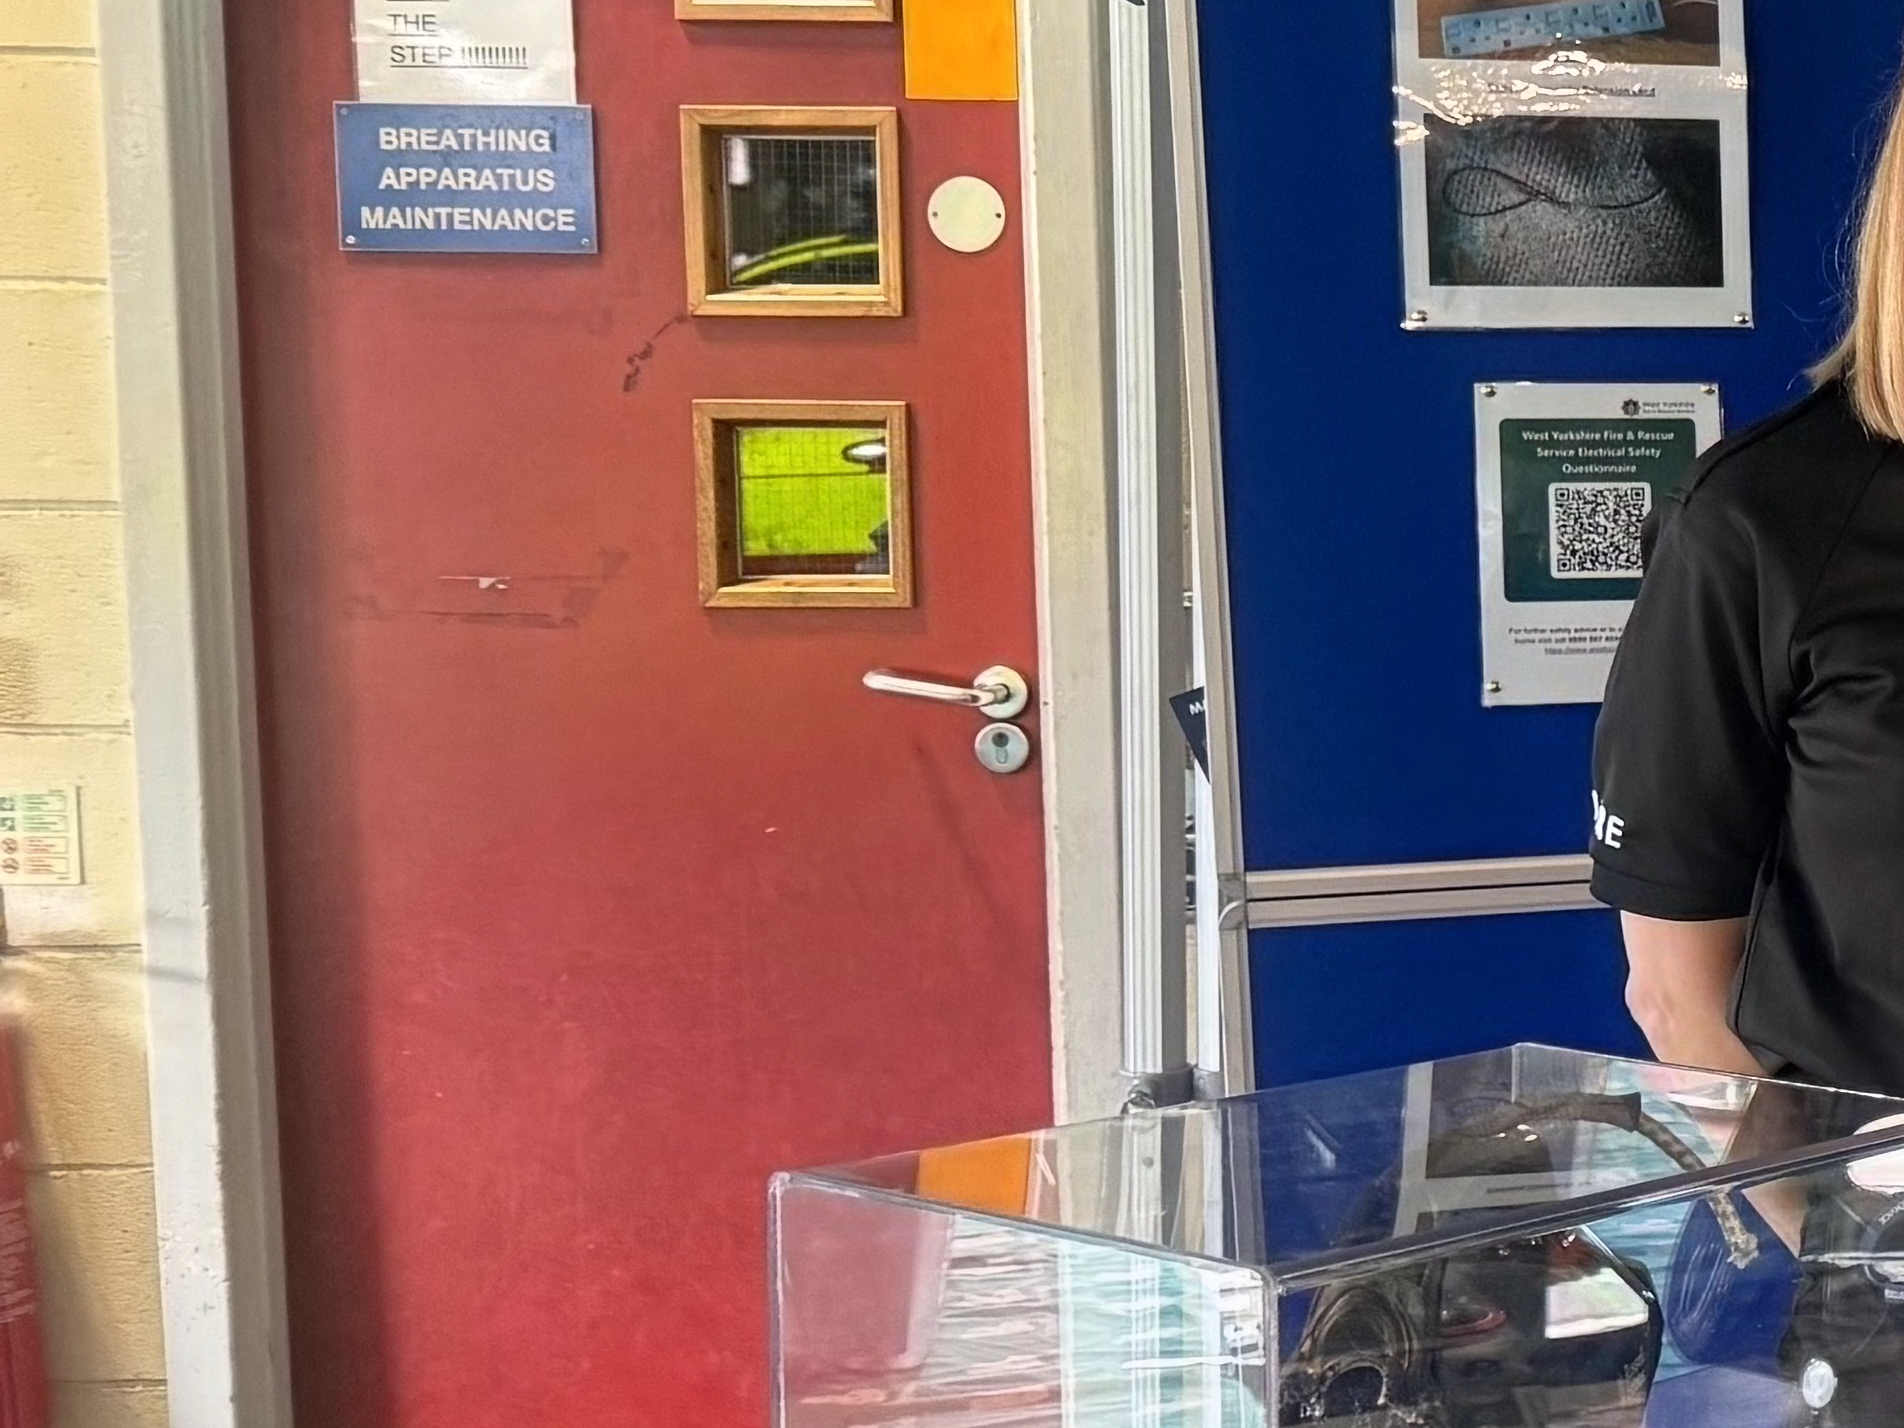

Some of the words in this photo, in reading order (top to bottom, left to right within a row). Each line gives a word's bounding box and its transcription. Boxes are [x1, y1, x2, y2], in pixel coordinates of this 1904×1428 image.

[387, 14, 437, 33] THE
[390, 45, 453, 64] STEP
[379, 127, 551, 152] BREATHING
[378, 167, 555, 191] APPARATUS
[361, 206, 576, 231] MAINTENANCE
[1522, 430, 1549, 441] West
[1552, 430, 1601, 441] Yorkshire
[1603, 430, 1623, 441] Fire
[1626, 430, 1635, 441] &
[1637, 430, 1674, 441] Rescue
[1537, 447, 1575, 457] Service
[1578, 447, 1626, 457] Electrical
[1628, 446, 1662, 459] Safety
[1562, 463, 1637, 475] Questionnaire
